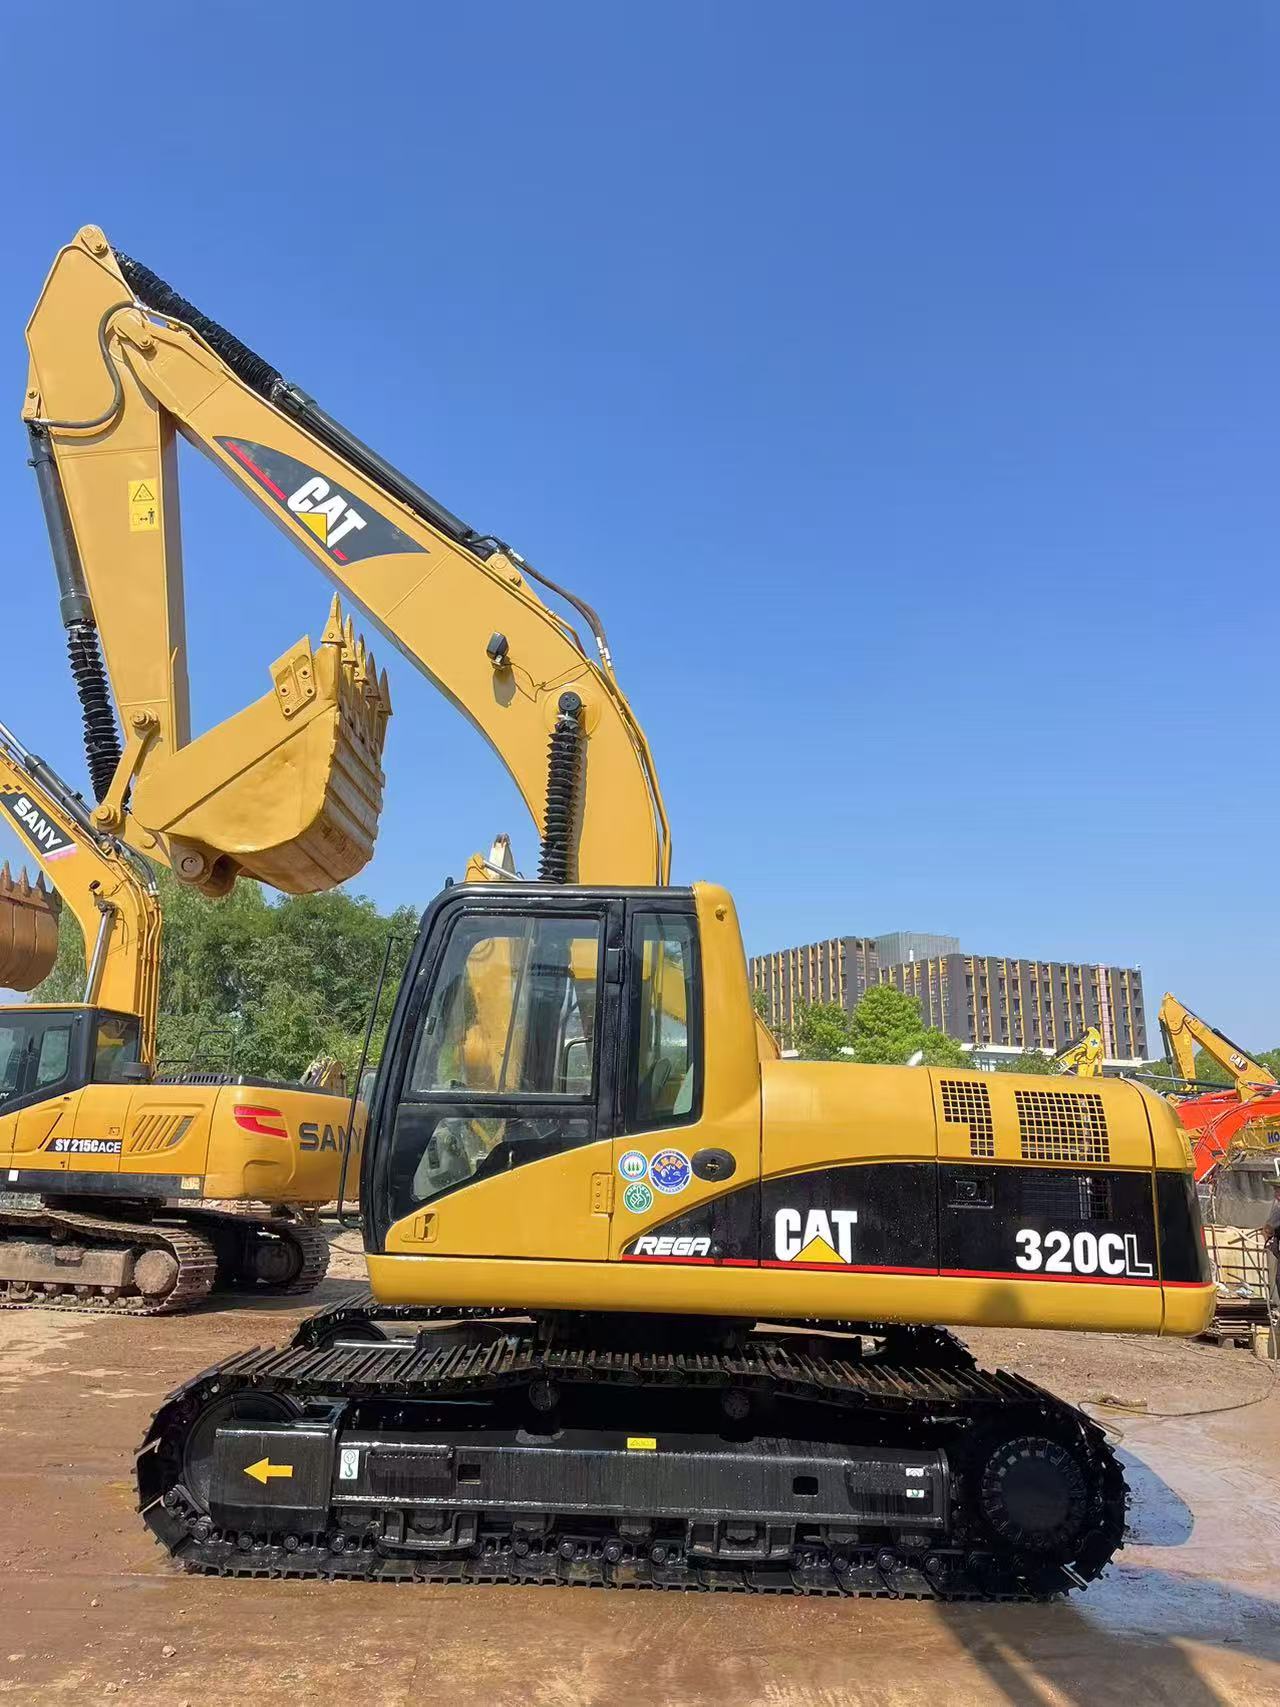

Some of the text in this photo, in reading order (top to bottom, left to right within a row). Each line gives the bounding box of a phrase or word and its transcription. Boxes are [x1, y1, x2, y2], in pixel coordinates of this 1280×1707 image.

[287, 476, 367, 548] CAT
[13, 797, 62, 849] SANY
[1229, 1053, 1247, 1068] CAT
[633, 1236, 711, 1256] REGA
[775, 1208, 857, 1264] CAT
[1015, 1229, 1153, 1276] 320CL
